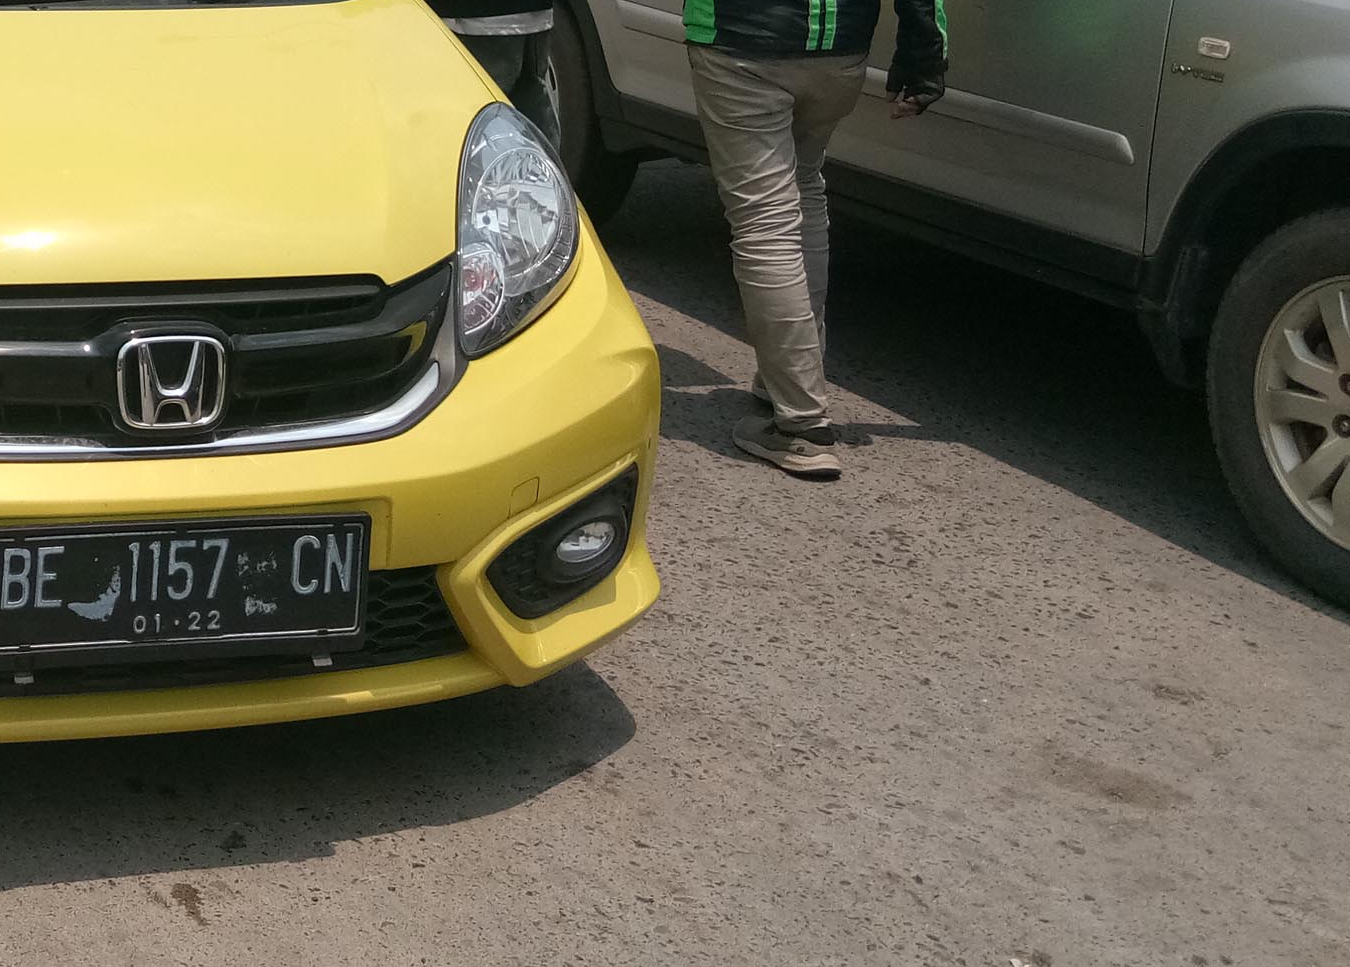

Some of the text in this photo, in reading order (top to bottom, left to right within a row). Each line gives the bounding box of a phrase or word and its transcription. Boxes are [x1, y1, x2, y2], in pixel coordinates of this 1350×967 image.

[0, 533, 354, 610] BE 1157 CN
